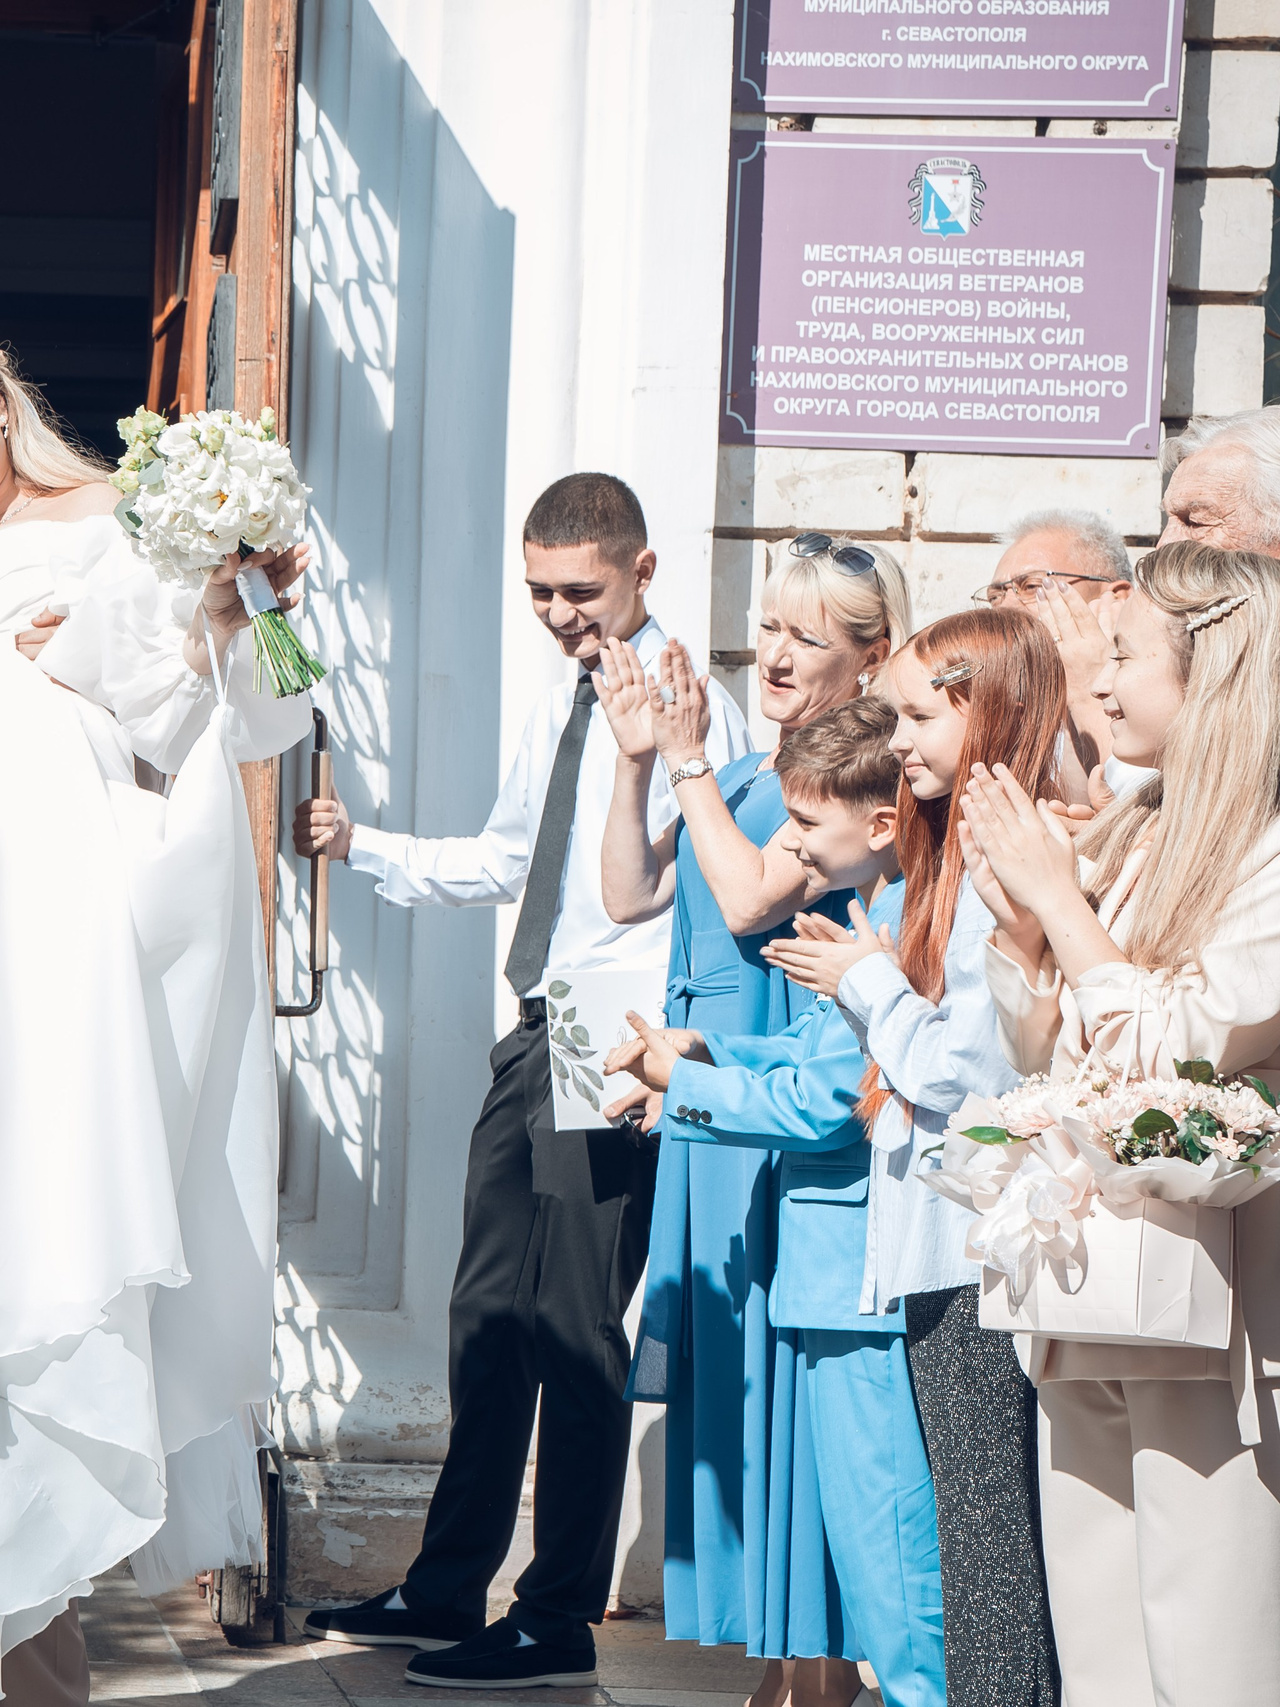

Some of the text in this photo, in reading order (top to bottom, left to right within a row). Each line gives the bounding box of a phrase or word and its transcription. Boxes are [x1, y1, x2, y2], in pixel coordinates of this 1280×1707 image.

[804, 0, 1110, 16] МУНИЦИПАЛЬНОГО ОБРАЗОВАНИЯ
[881, 25, 1027, 43] г. СЕВАСТОПОЛЯ
[760, 50, 1149, 72] НАХИМОВСКОГО МУНИЦИПАЛЬНОГО ОКРУГА
[803, 243, 1085, 269] МЕСТНАЯ ОБЩЕСТВЕННАЯ
[801, 269, 1085, 294] ОРГАНИЗАЦИЯ ВЕТЕРАНОВ
[810, 294, 1071, 323] (ПЕНСИОНЕРОВ) ВОЙНЫ,
[795, 320, 1085, 346] ТРУДА, ВООРУЖЕННЫХ СИЛ
[751, 344, 1129, 373] И ПРАВООХРАНИТЕЛЬНЫХ ОРГАНОВ
[750, 370, 1128, 398] НАХИМОВСКОГО МУНИЦИПАЛЬНОГО
[773, 396, 1101, 424] ОКРУГА ГОРОДА СЕВАСТОПОЛЯ
